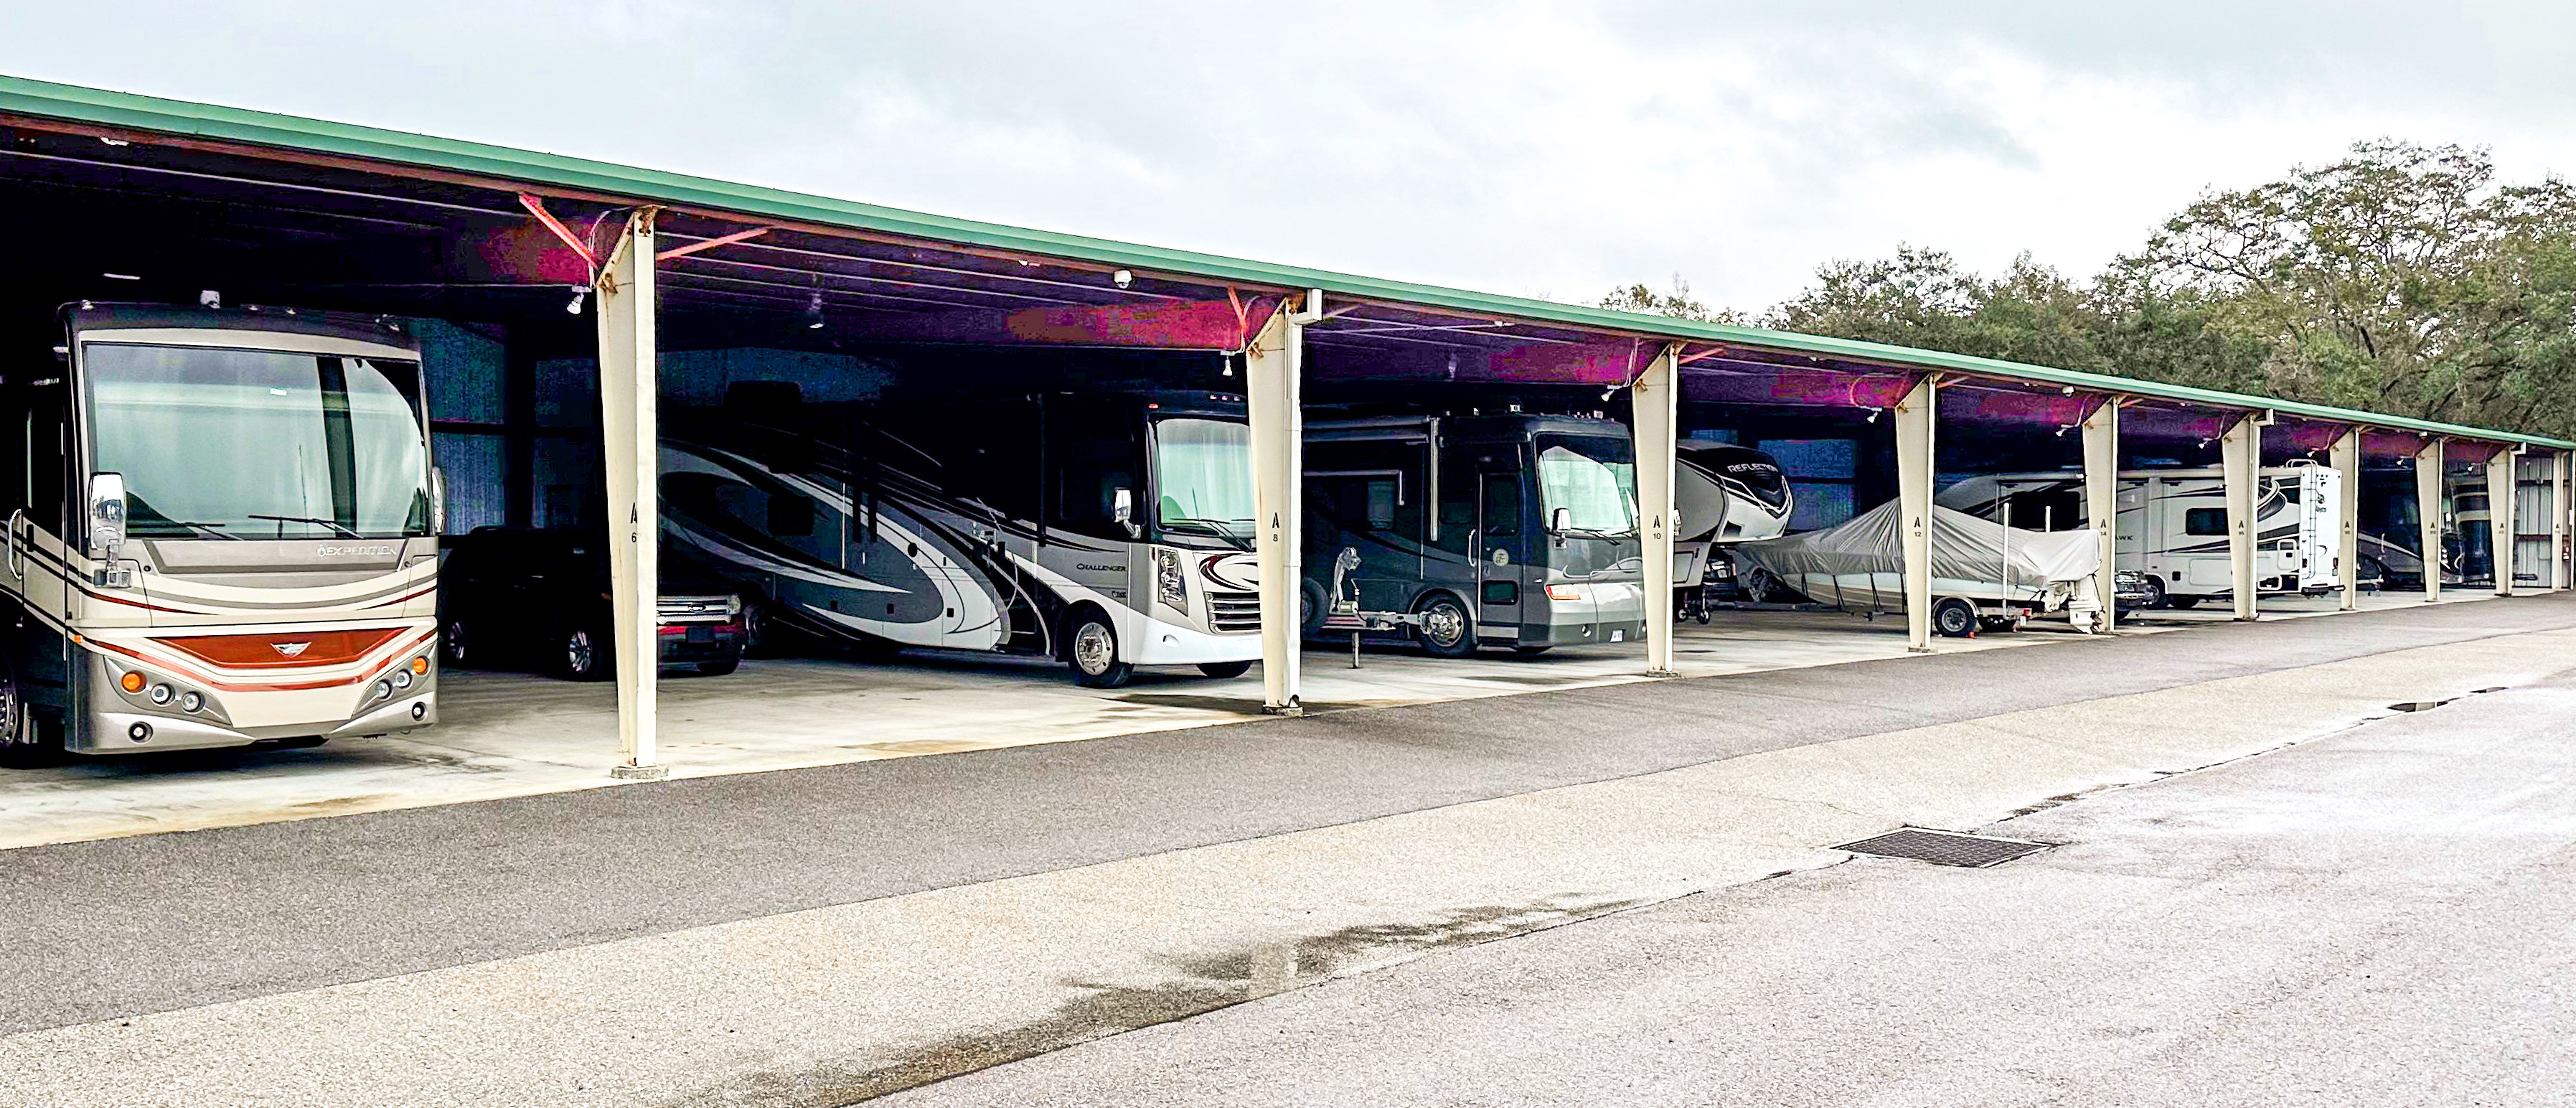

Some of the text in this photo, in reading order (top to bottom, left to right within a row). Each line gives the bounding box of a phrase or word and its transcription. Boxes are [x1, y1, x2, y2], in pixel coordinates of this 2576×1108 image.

[630, 502, 637, 524] A
[1272, 512, 1279, 528] A
[1653, 515, 1660, 528] A
[1914, 517, 1921, 527] A
[2100, 518, 2107, 528] A
[2238, 520, 2244, 528] A
[631, 532, 637, 543] 6
[1273, 533, 1279, 542] 8
[326, 545, 398, 556] EXPEDITION
[1076, 563, 1127, 572] CHALLENGER
